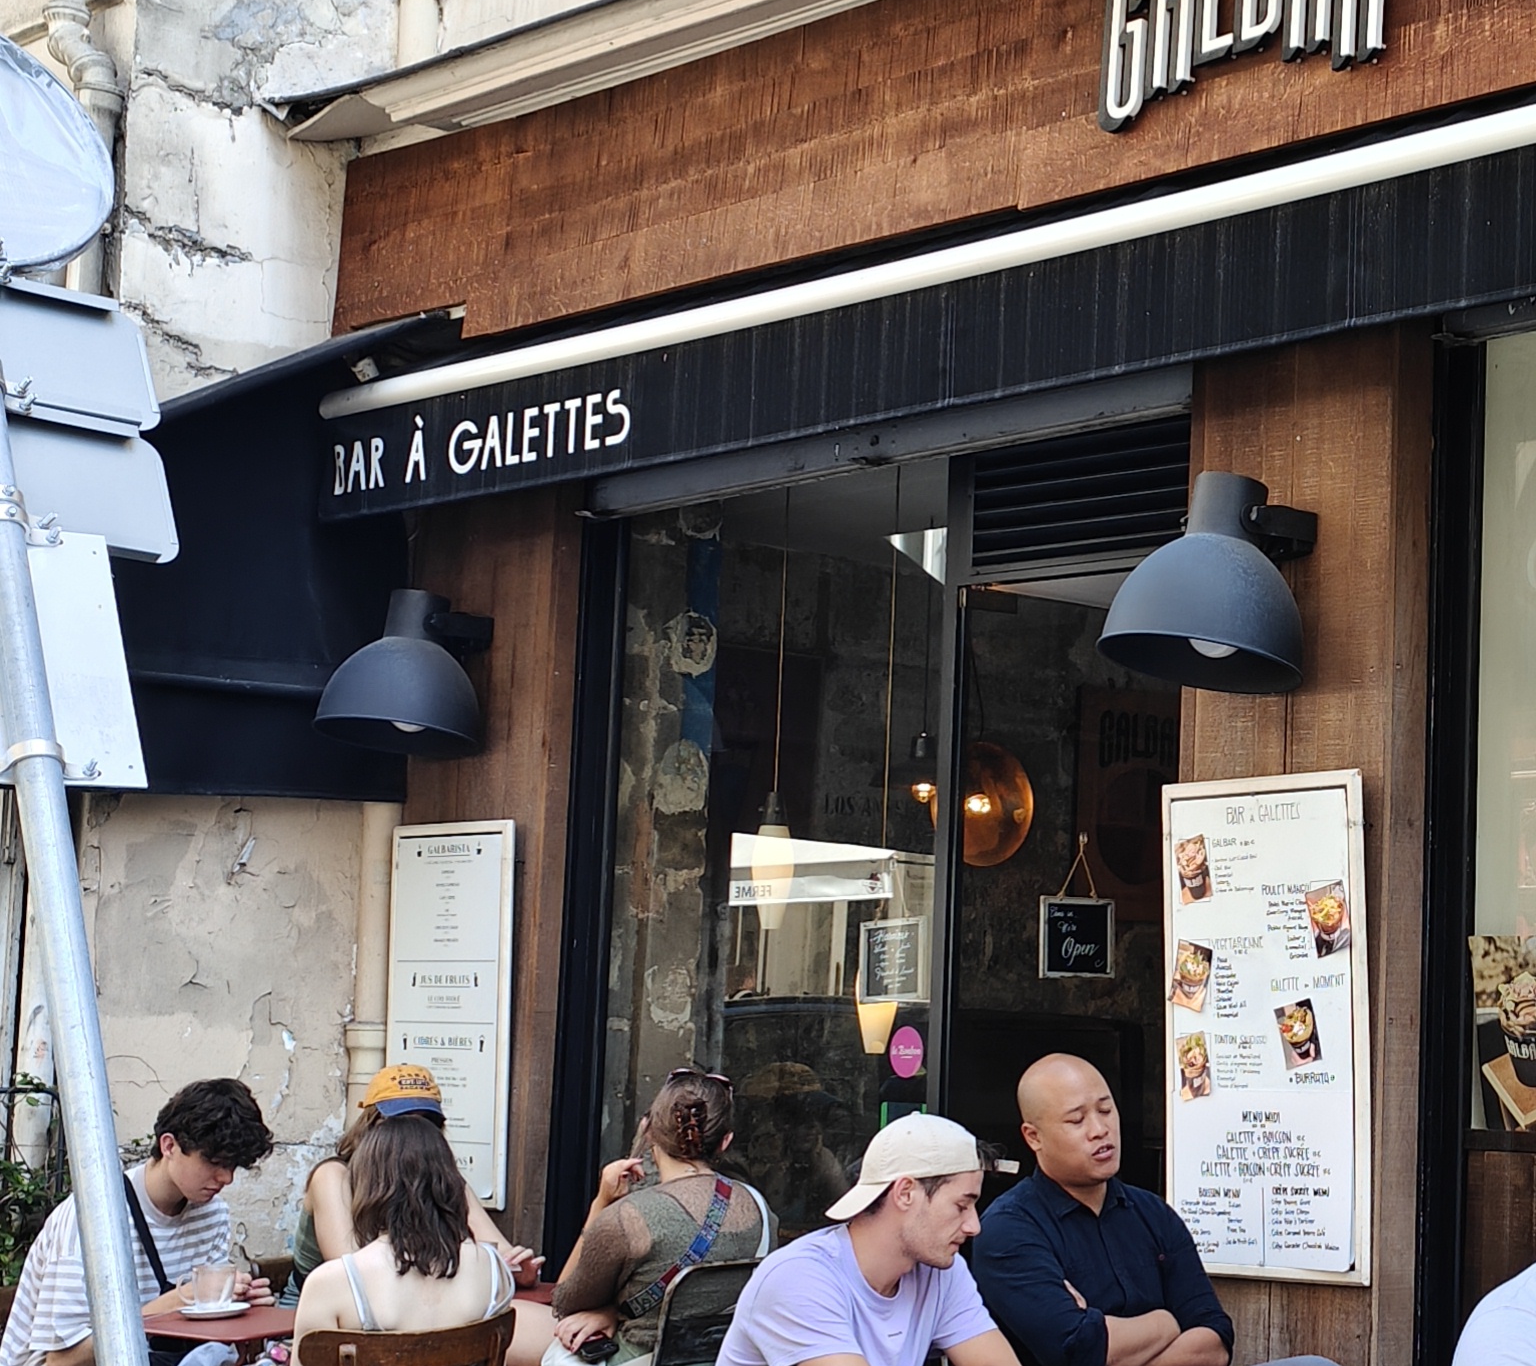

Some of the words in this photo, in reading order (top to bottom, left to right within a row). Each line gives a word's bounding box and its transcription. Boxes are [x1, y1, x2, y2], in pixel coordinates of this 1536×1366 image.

[333, 437, 385, 496] BAR
[405, 414, 427, 484] À
[448, 388, 631, 475] GALETTES
[1226, 806, 1245, 825] BAR
[1258, 802, 1301, 823] GALETTES
[1061, 936, 1099, 966] Open
[445, 974, 471, 985] FRUITS
